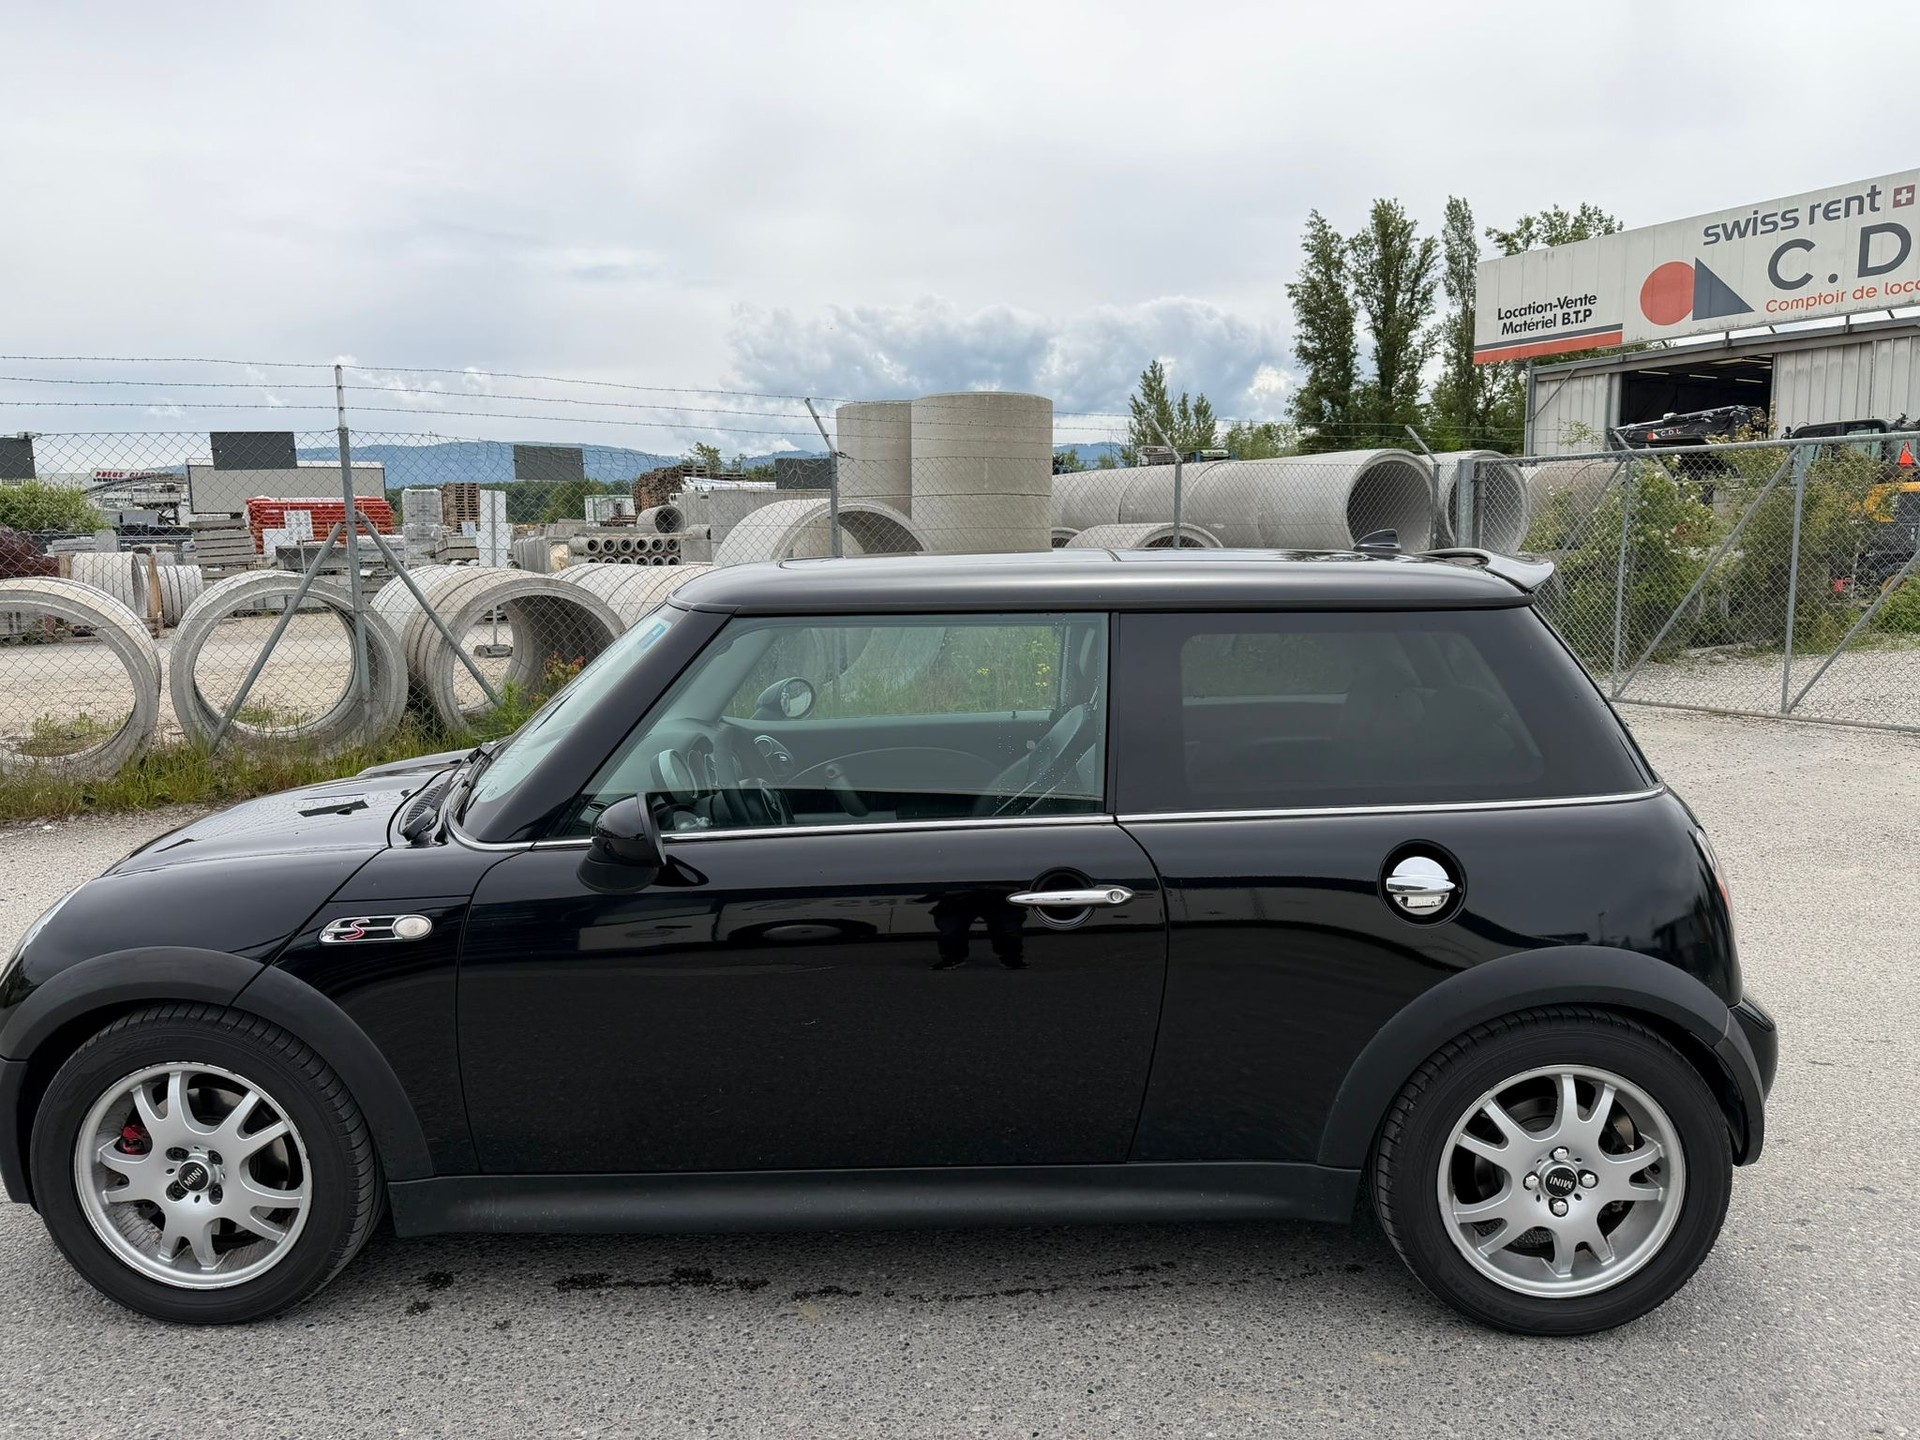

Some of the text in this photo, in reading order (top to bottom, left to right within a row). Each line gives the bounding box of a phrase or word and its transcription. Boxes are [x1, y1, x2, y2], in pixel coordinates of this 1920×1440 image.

[1703, 184, 1882, 246] swiss rent
[1497, 293, 1597, 321] Location-Vente
[1765, 289, 1847, 313] Comptoir
[1852, 285, 1878, 301] de
[1501, 308, 1592, 335] Matériel B.T.P
[340, 919, 370, 942] S
[184, 1167, 203, 1187] MINI
[1549, 1176, 1574, 1189] MINI
